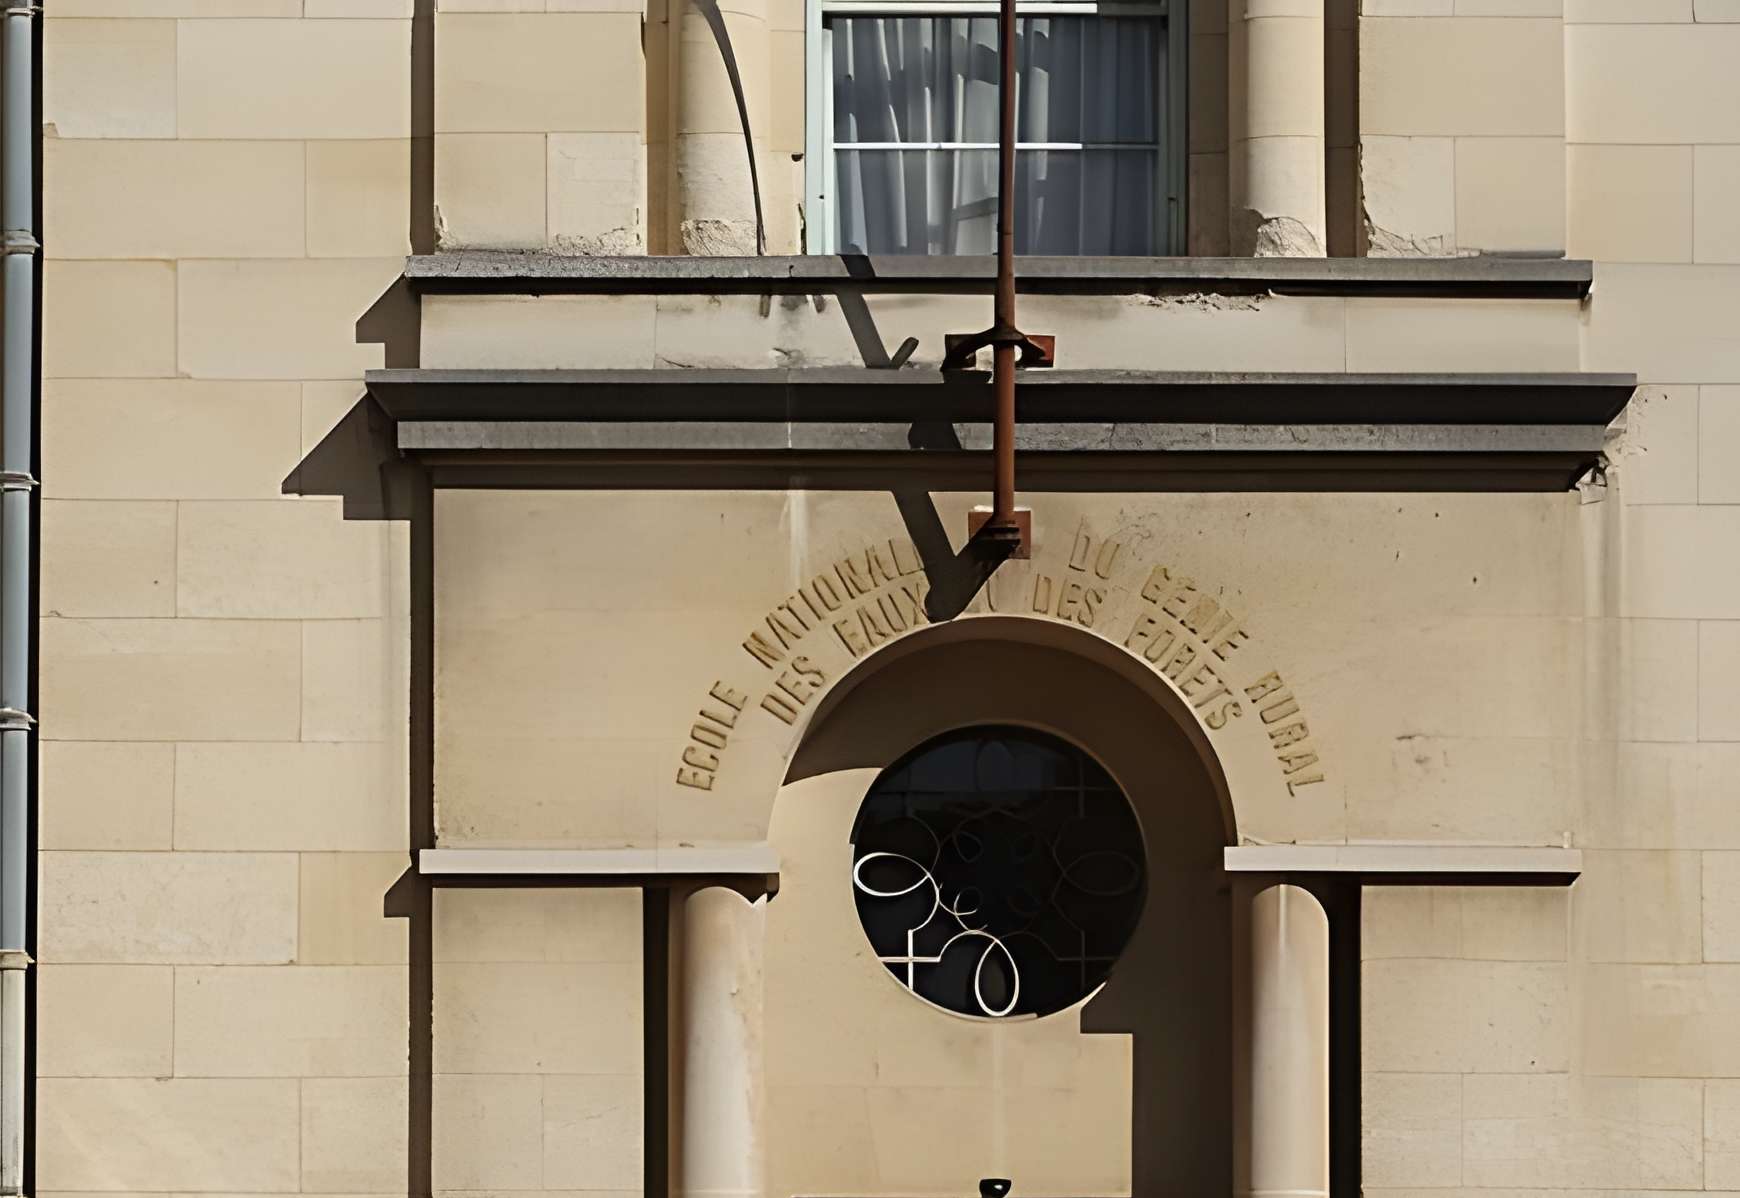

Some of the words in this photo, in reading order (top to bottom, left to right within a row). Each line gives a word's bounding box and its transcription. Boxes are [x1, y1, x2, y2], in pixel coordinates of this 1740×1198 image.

[676, 679, 748, 791] ECOLE
[742, 537, 925, 669] NATIONAL
[1068, 518, 1121, 580] DU
[1244, 670, 1325, 797] RURAL
[760, 656, 825, 726] DES
[832, 583, 929, 658] EAUX
[1032, 573, 1104, 628] DES
